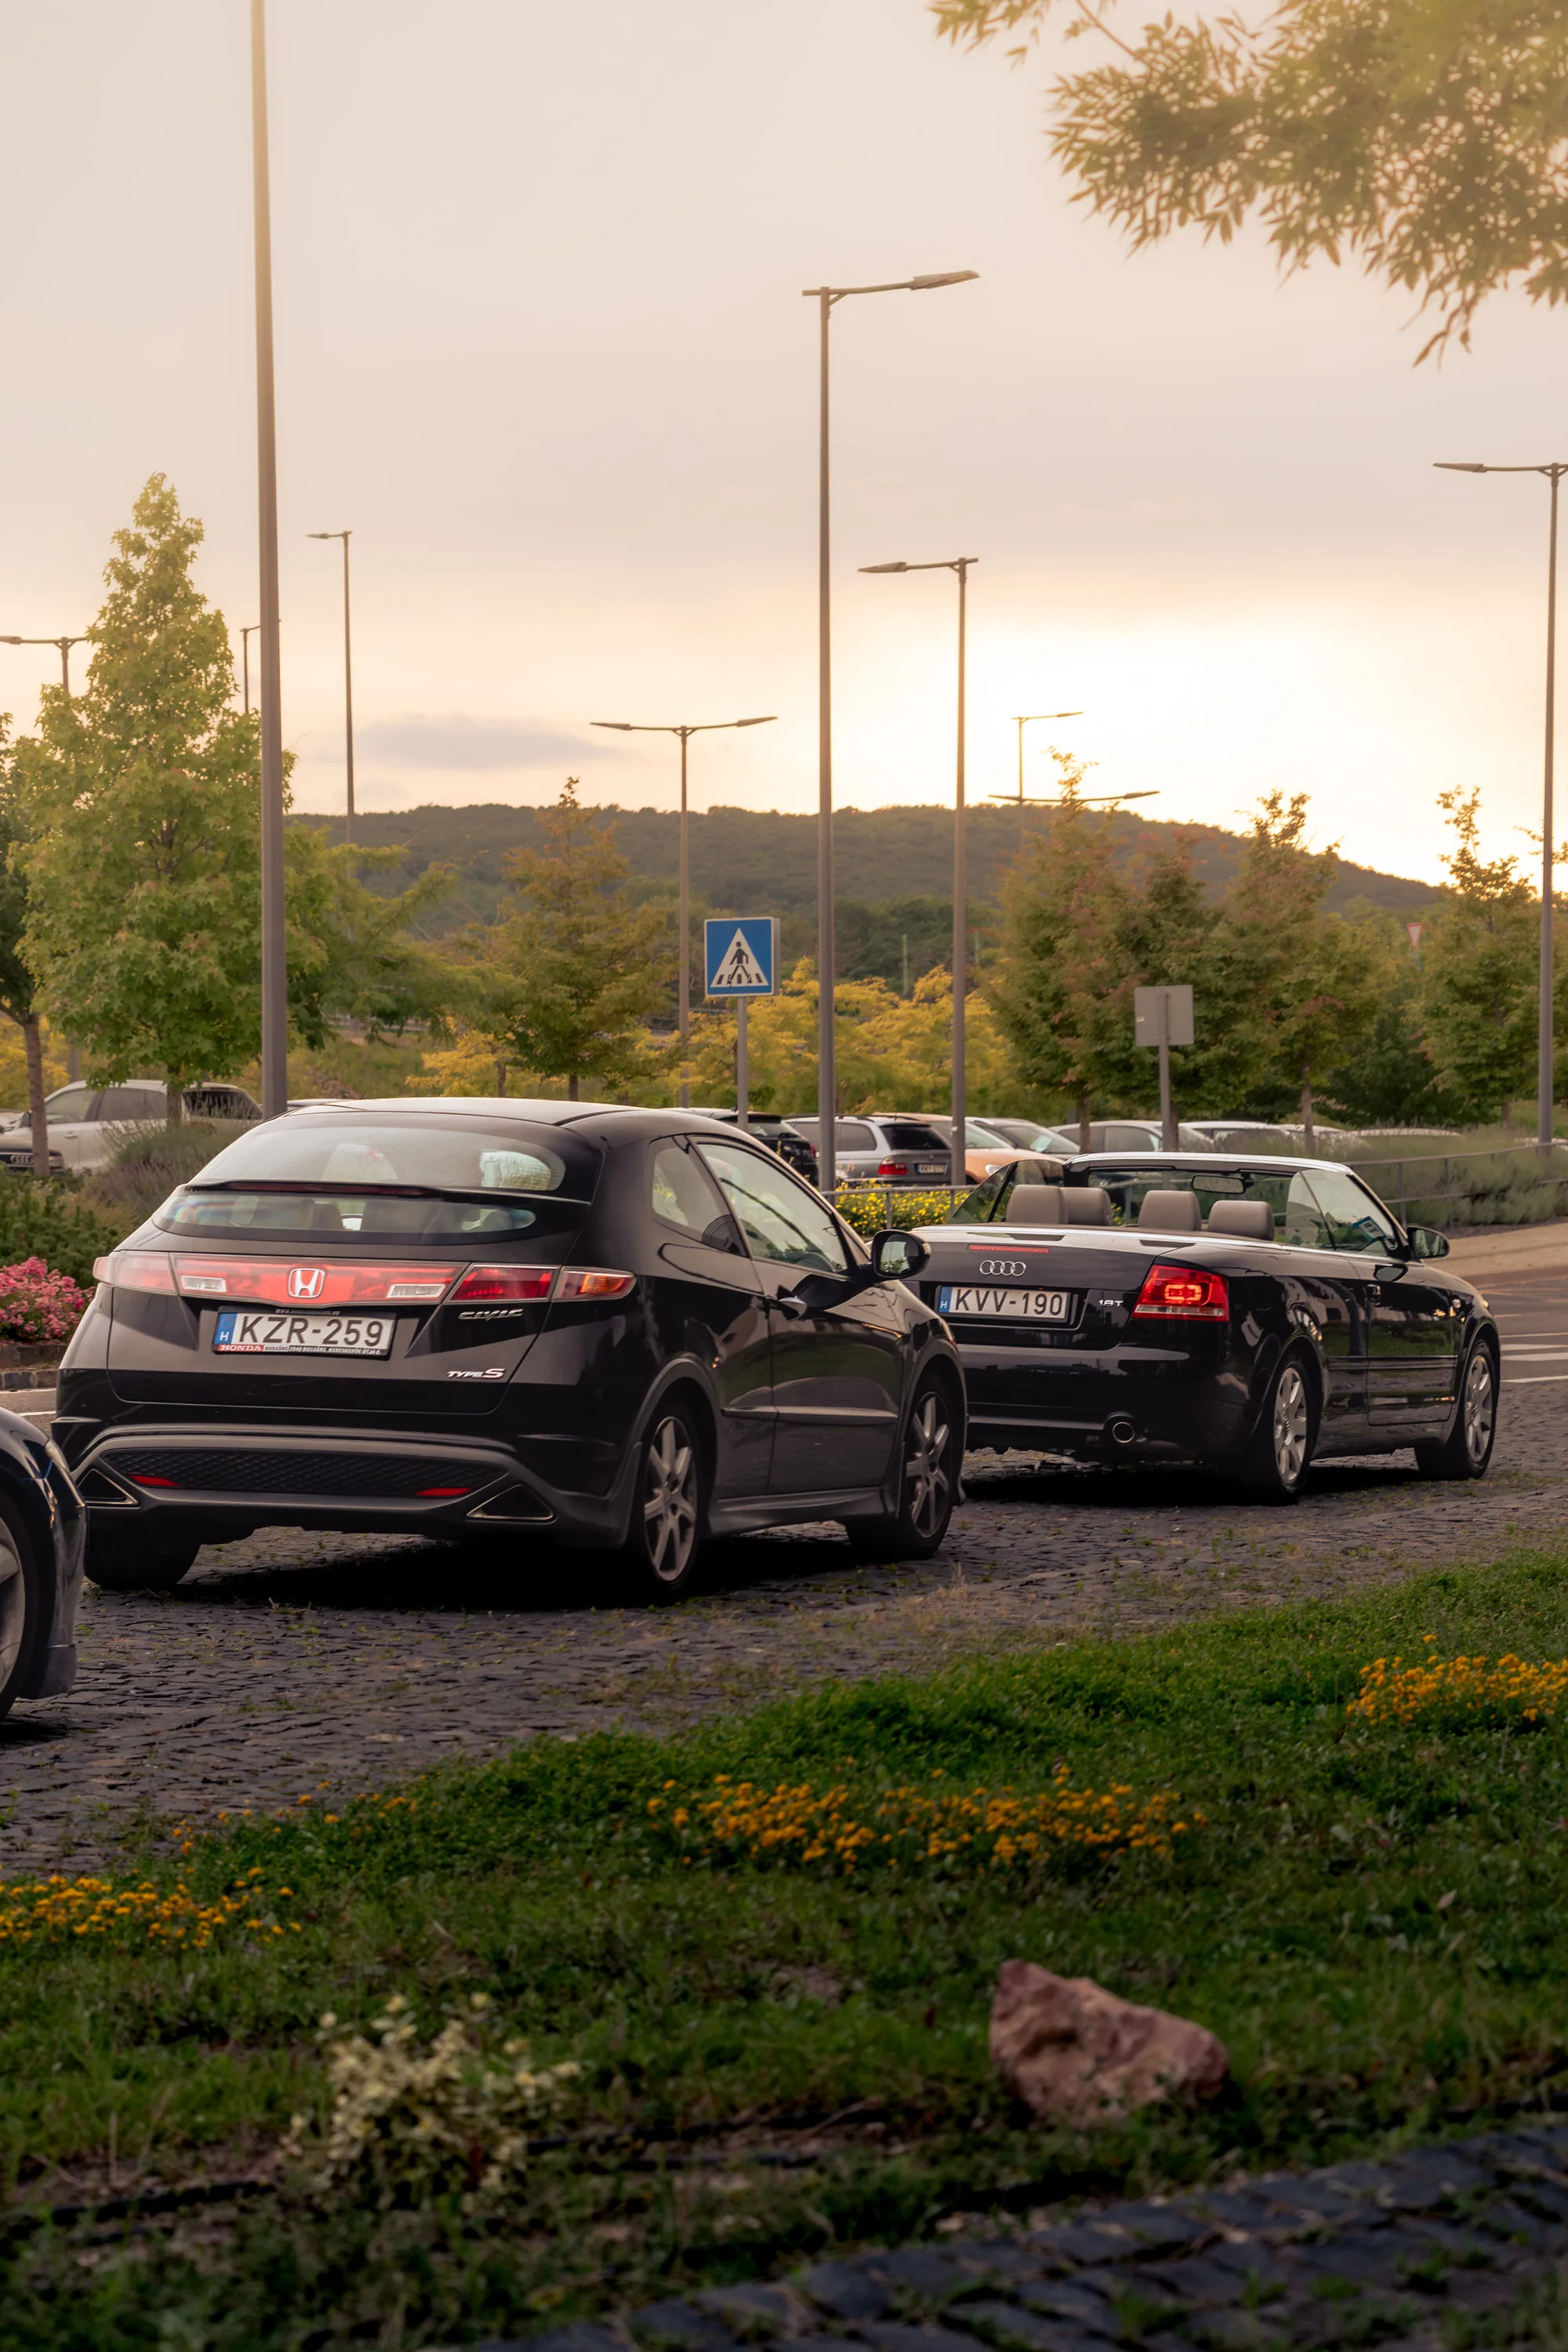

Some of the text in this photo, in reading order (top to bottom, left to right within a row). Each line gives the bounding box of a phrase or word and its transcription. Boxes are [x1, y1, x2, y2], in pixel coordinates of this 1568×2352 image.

[955, 1289, 1062, 1316] KVV-190
[458, 1308, 524, 1321] CIVIC
[219, 1331, 230, 1341] H
[238, 1316, 383, 1347] KZR-259
[447, 1368, 506, 1379] TYPE S
